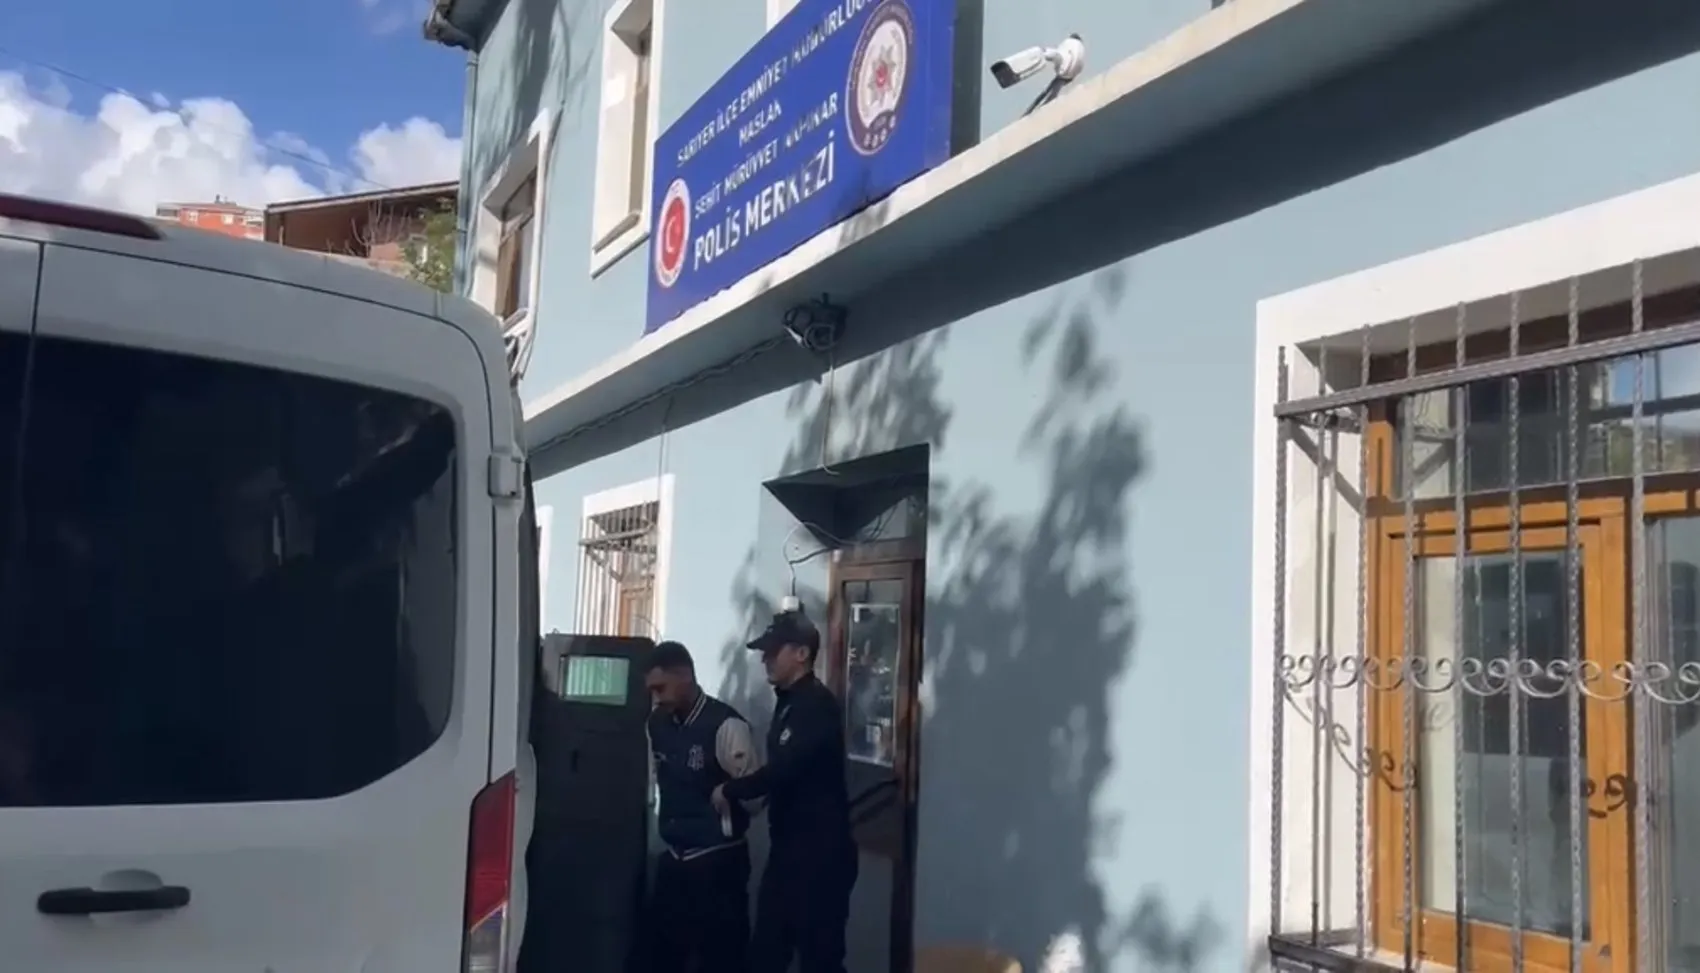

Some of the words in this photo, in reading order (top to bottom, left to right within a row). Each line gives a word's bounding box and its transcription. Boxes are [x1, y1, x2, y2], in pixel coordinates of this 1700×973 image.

[739, 98, 782, 148] MASLAK
[693, 206, 741, 271] POLİS
[745, 128, 835, 237] MERKEZİ
